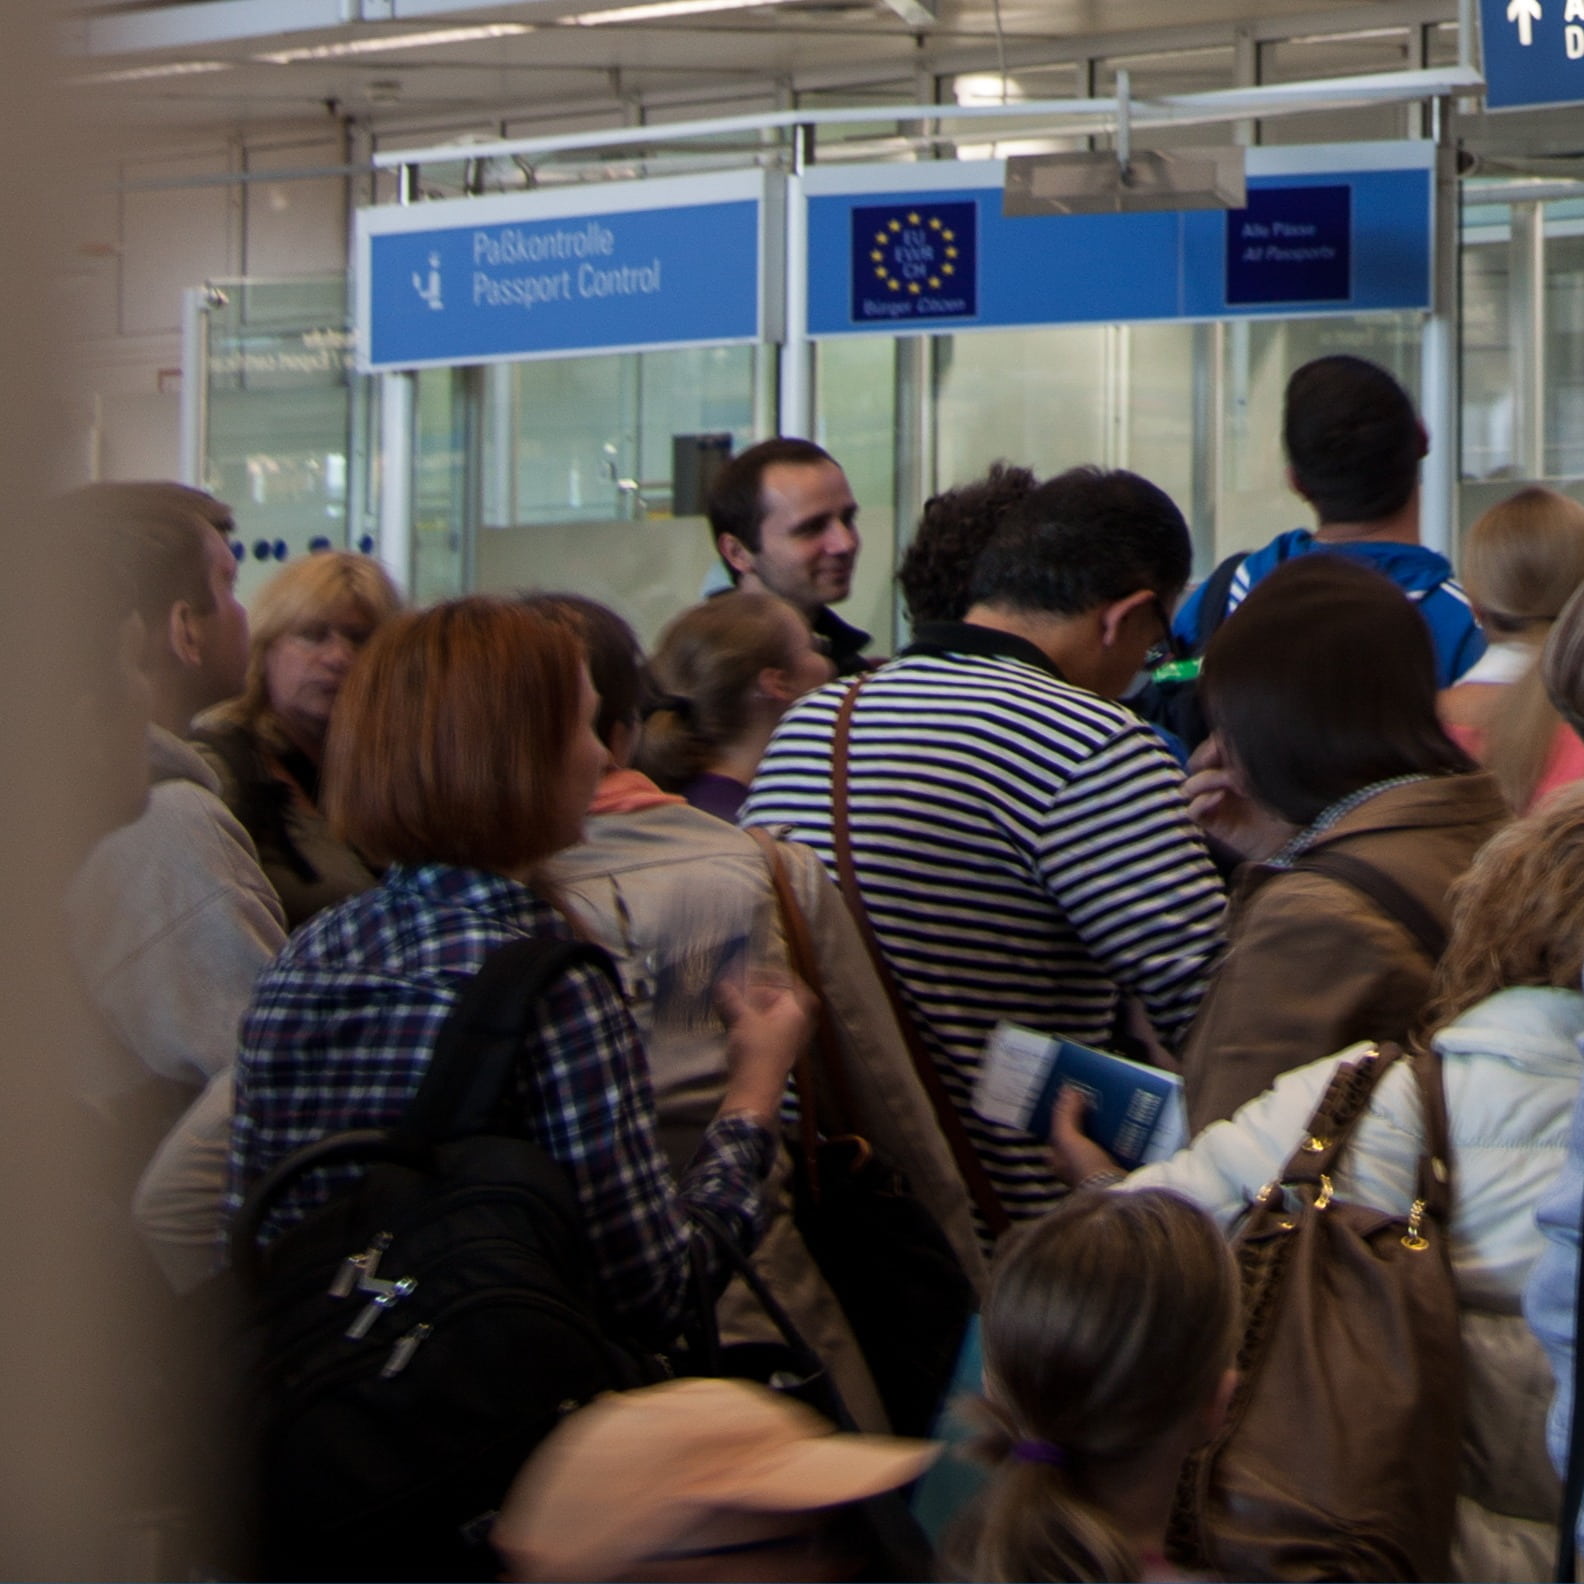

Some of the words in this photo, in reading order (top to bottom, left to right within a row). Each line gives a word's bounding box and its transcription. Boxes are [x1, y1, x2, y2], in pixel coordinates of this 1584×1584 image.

[473, 222, 614, 266] Paßkontrolle
[473, 269, 571, 309] Passport
[578, 257, 661, 298] Control
